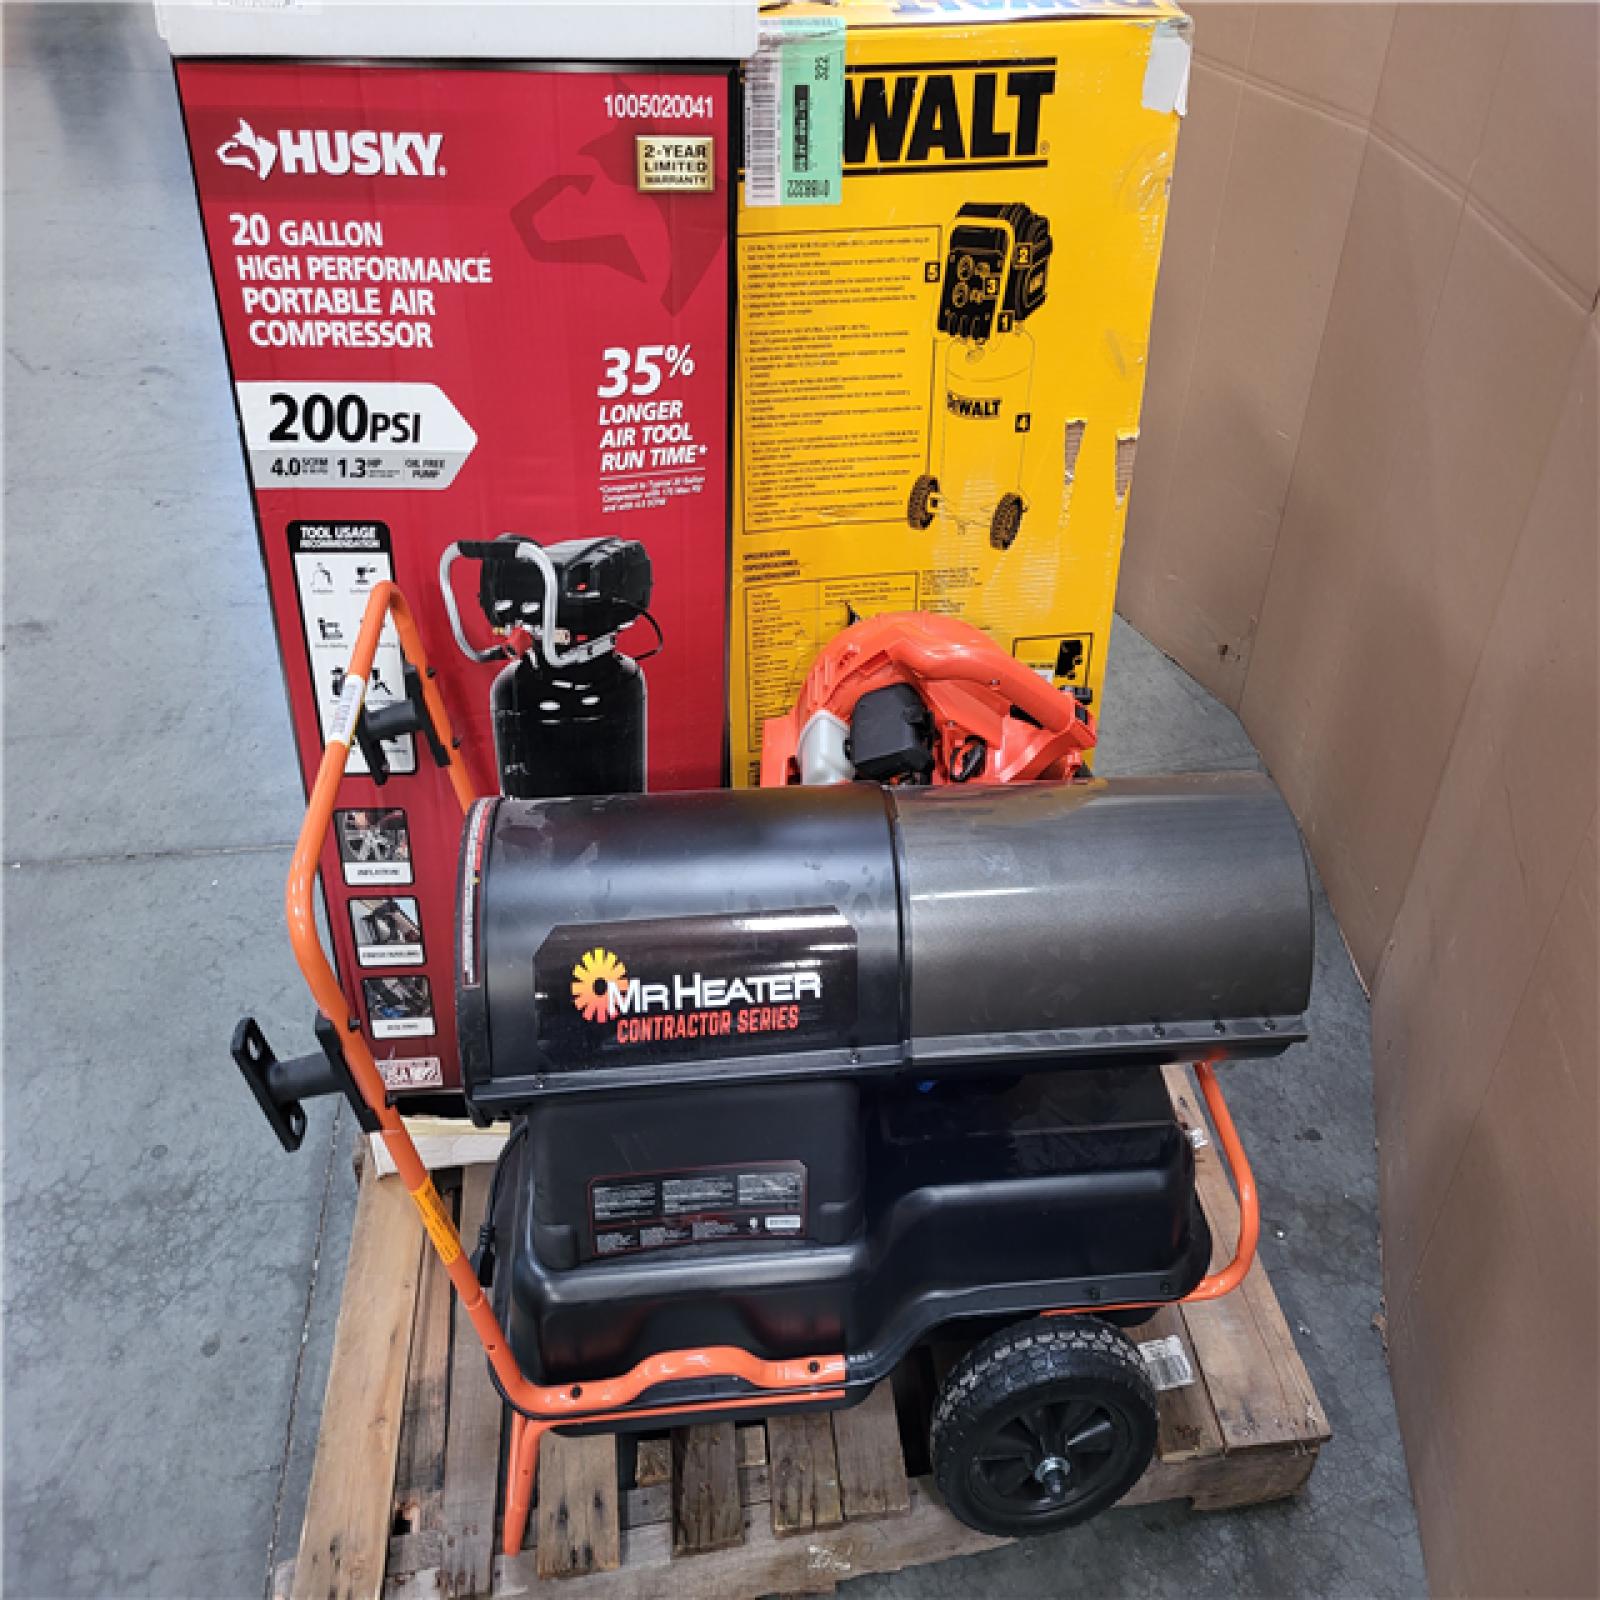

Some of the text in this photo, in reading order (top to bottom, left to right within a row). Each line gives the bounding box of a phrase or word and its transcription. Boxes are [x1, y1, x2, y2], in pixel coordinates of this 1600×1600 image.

[603, 93, 713, 118] 1005020041
[844, 71, 1055, 162] WALT
[278, 130, 443, 176] HUSKY
[643, 144, 707, 158] 2-YEAR
[643, 160, 708, 173] LIMITED
[229, 213, 383, 248] 20 GALLON
[236, 255, 492, 284] HIGH PERFORMANCE
[243, 287, 436, 316] PORTABLE AIR
[249, 320, 434, 349] COMPRESSOR
[596, 343, 695, 398] 35%
[598, 400, 684, 426] LONGER
[599, 422, 694, 449] AIR TOOL
[269, 456, 301, 478] 4.0
[337, 456, 366, 479] 1.3
[601, 450, 646, 472] RUN
[299, 525, 378, 539] TOOL USAGE
[674, 972, 822, 1008] HEATER
[615, 1004, 799, 1045] CONTRACTOR SERIES
